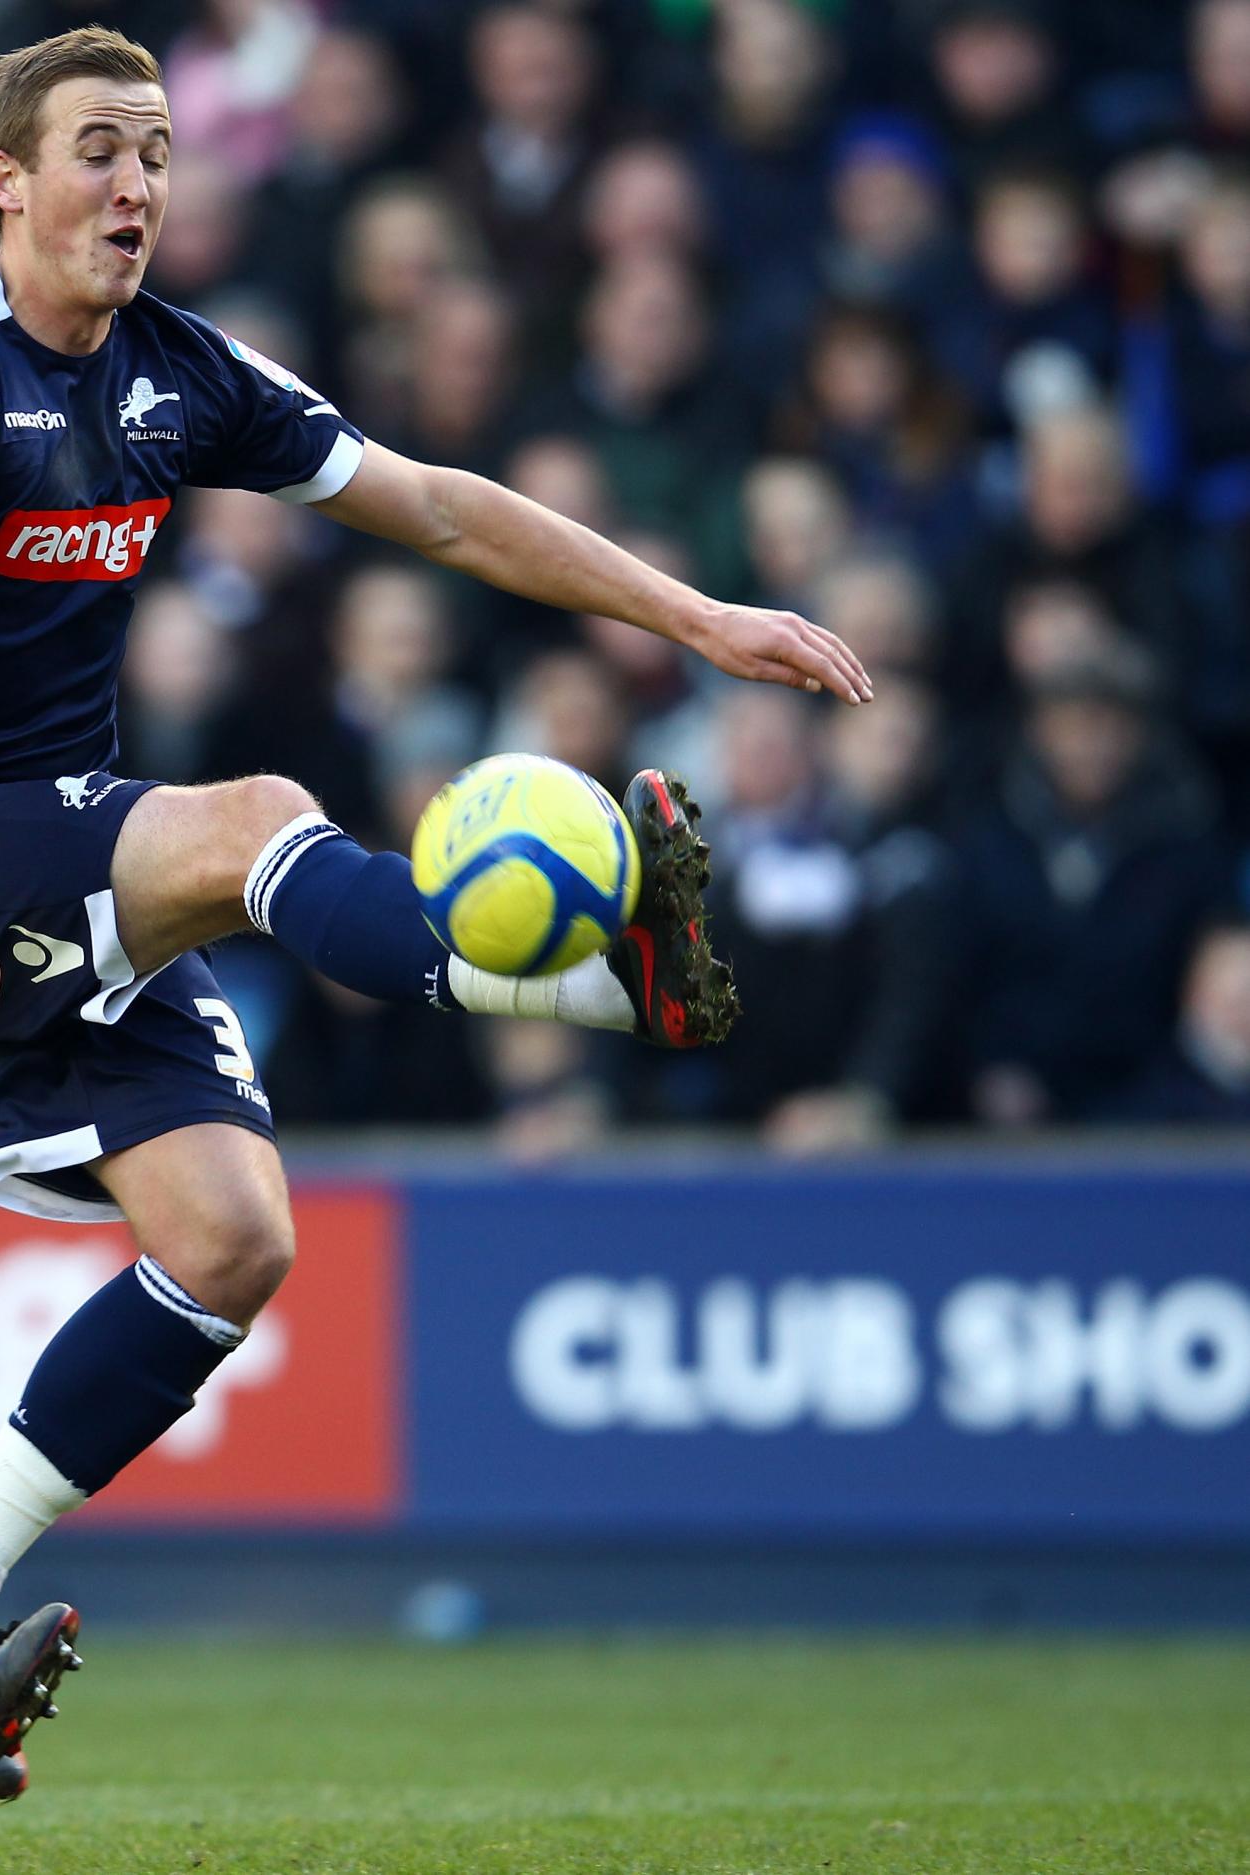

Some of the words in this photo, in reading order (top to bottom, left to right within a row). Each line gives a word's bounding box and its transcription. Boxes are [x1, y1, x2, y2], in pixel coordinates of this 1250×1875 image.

[4, 409, 67, 430] macron
[126, 430, 180, 441] MILLWALL
[509, 1276, 918, 1432] CLUB
[938, 1276, 1250, 1432] SHO
